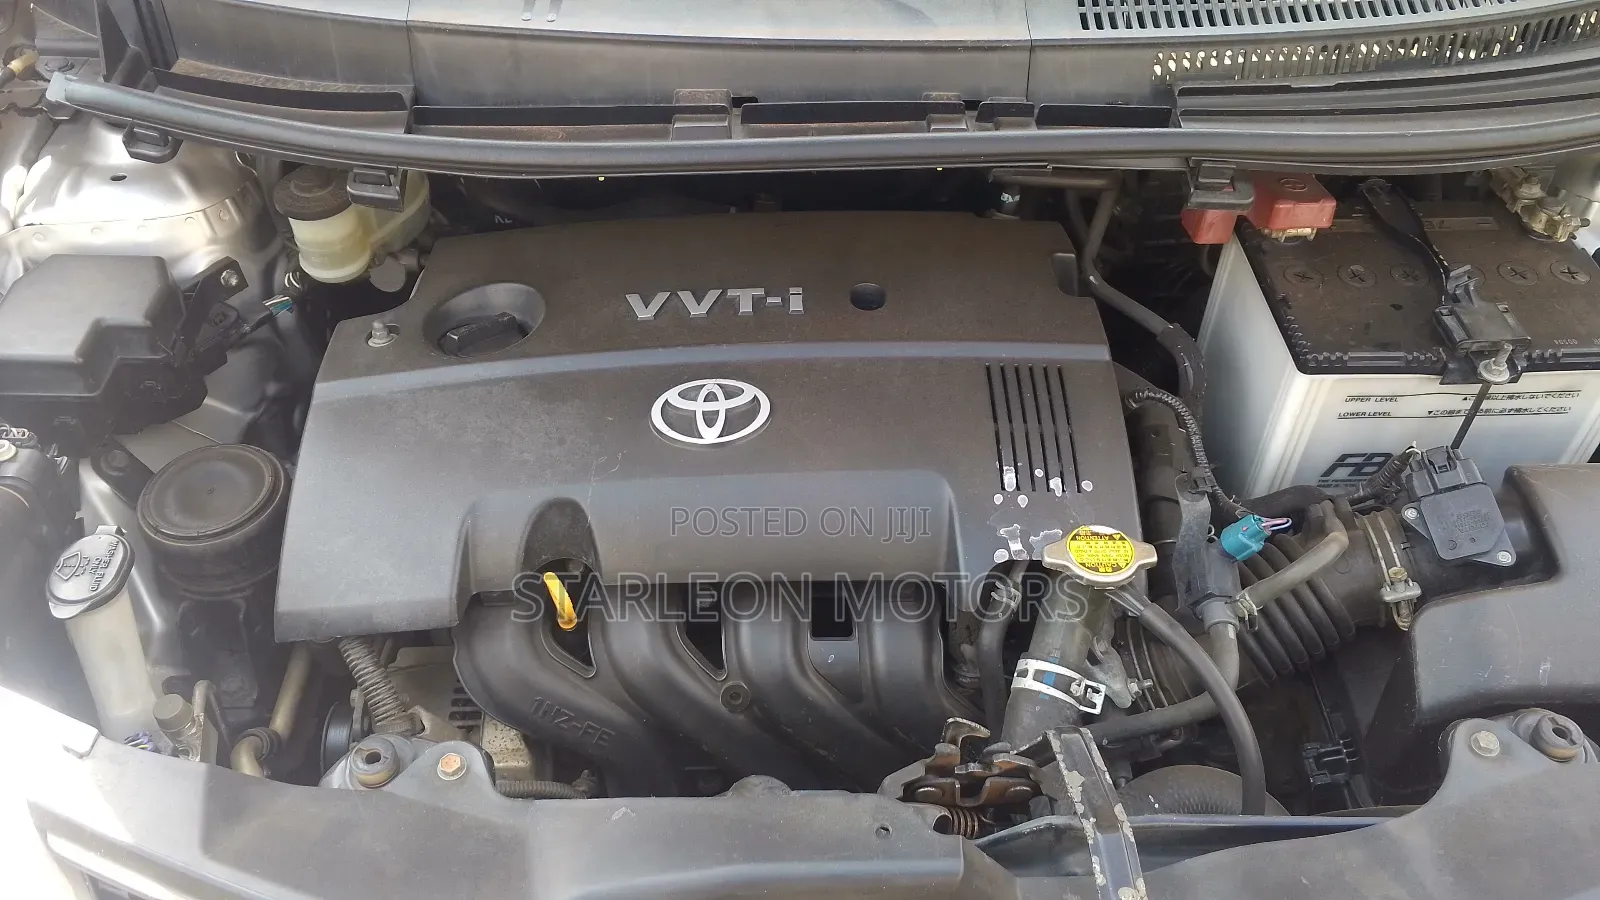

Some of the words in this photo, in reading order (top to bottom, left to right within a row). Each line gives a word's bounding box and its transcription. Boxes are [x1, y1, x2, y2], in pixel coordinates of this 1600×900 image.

[625, 287, 804, 320] VVT-i
[89, 556, 102, 575] ONLY
[100, 540, 120, 569] WASHER
[89, 571, 105, 592] FLUID
